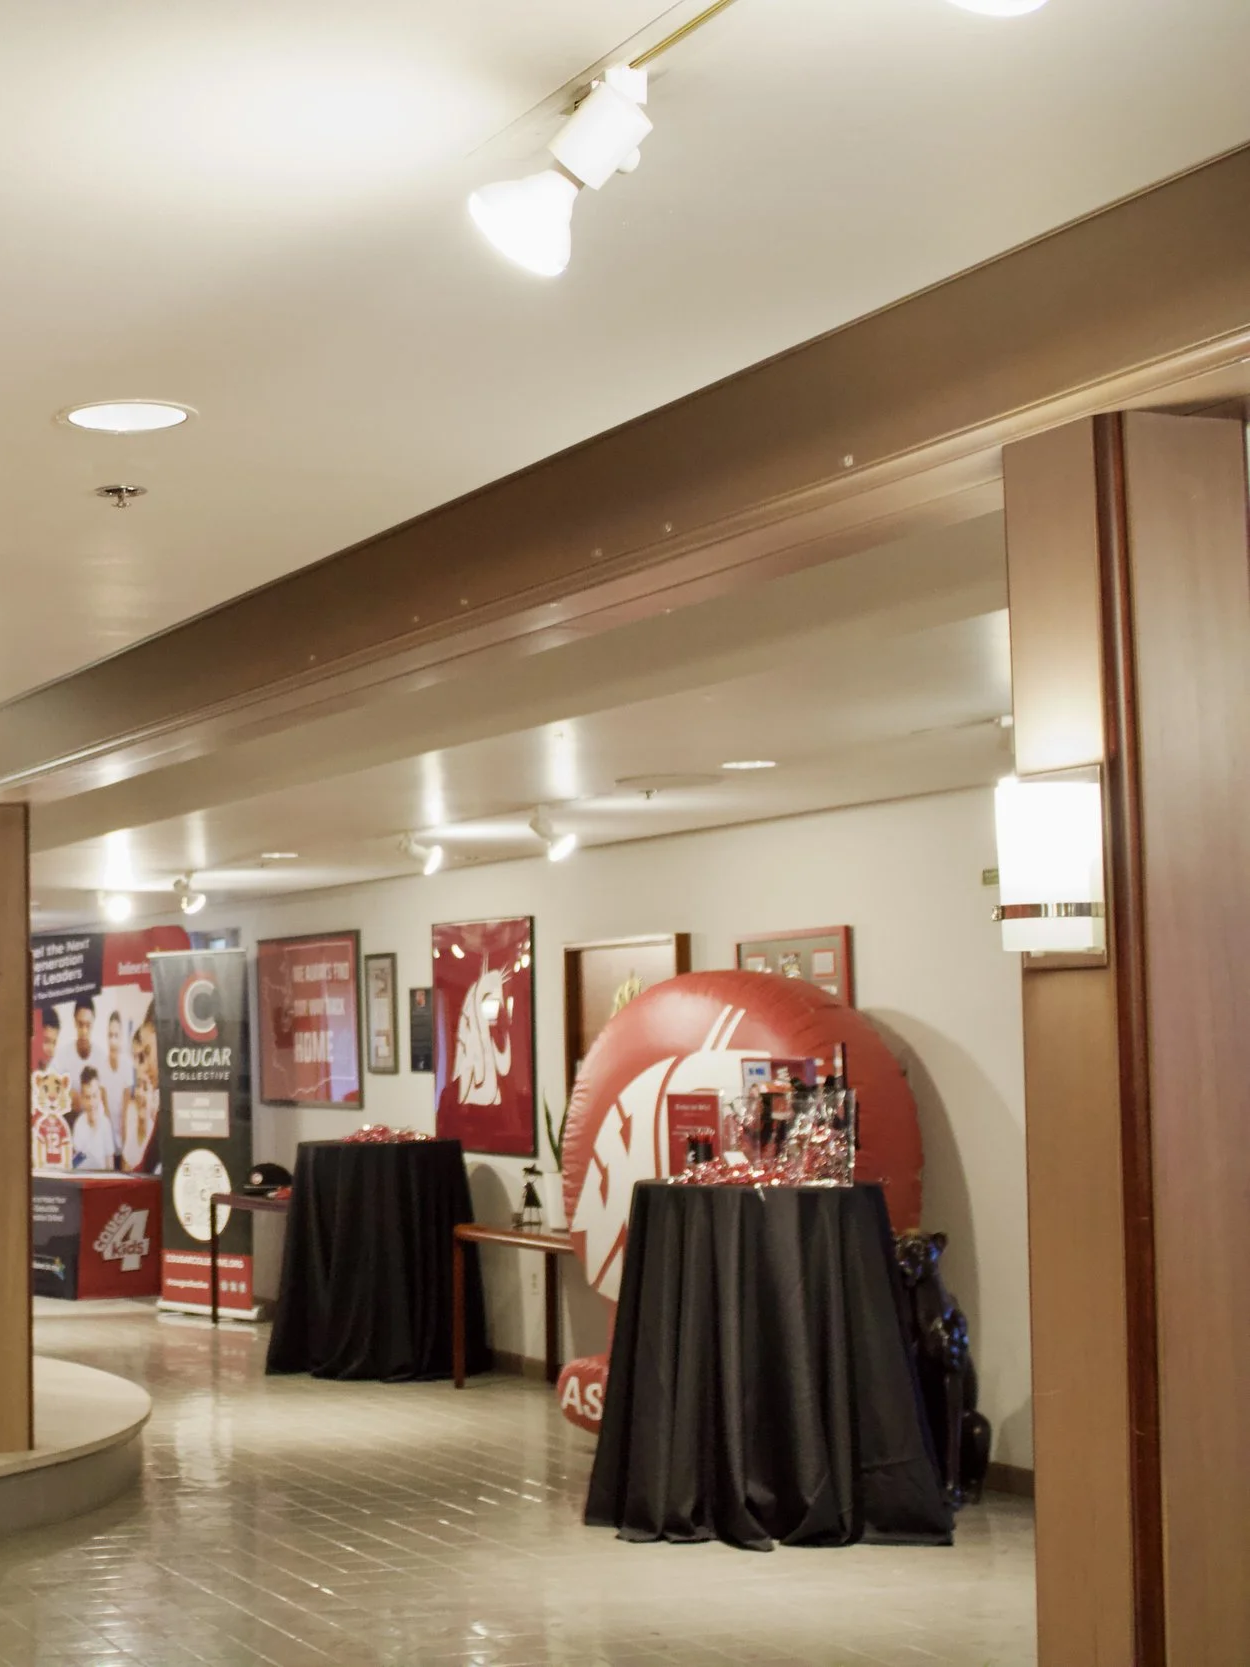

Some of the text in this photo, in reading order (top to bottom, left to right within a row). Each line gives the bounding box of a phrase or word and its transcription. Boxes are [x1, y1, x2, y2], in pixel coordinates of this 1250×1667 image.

[33, 954, 85, 974] eneration
[166, 1047, 232, 1068] COUGAR
[171, 1071, 231, 1081] COLLECTIVE
[103, 1209, 150, 1272] 4
[111, 1239, 144, 1257] kids
[561, 1376, 604, 1421] AS
